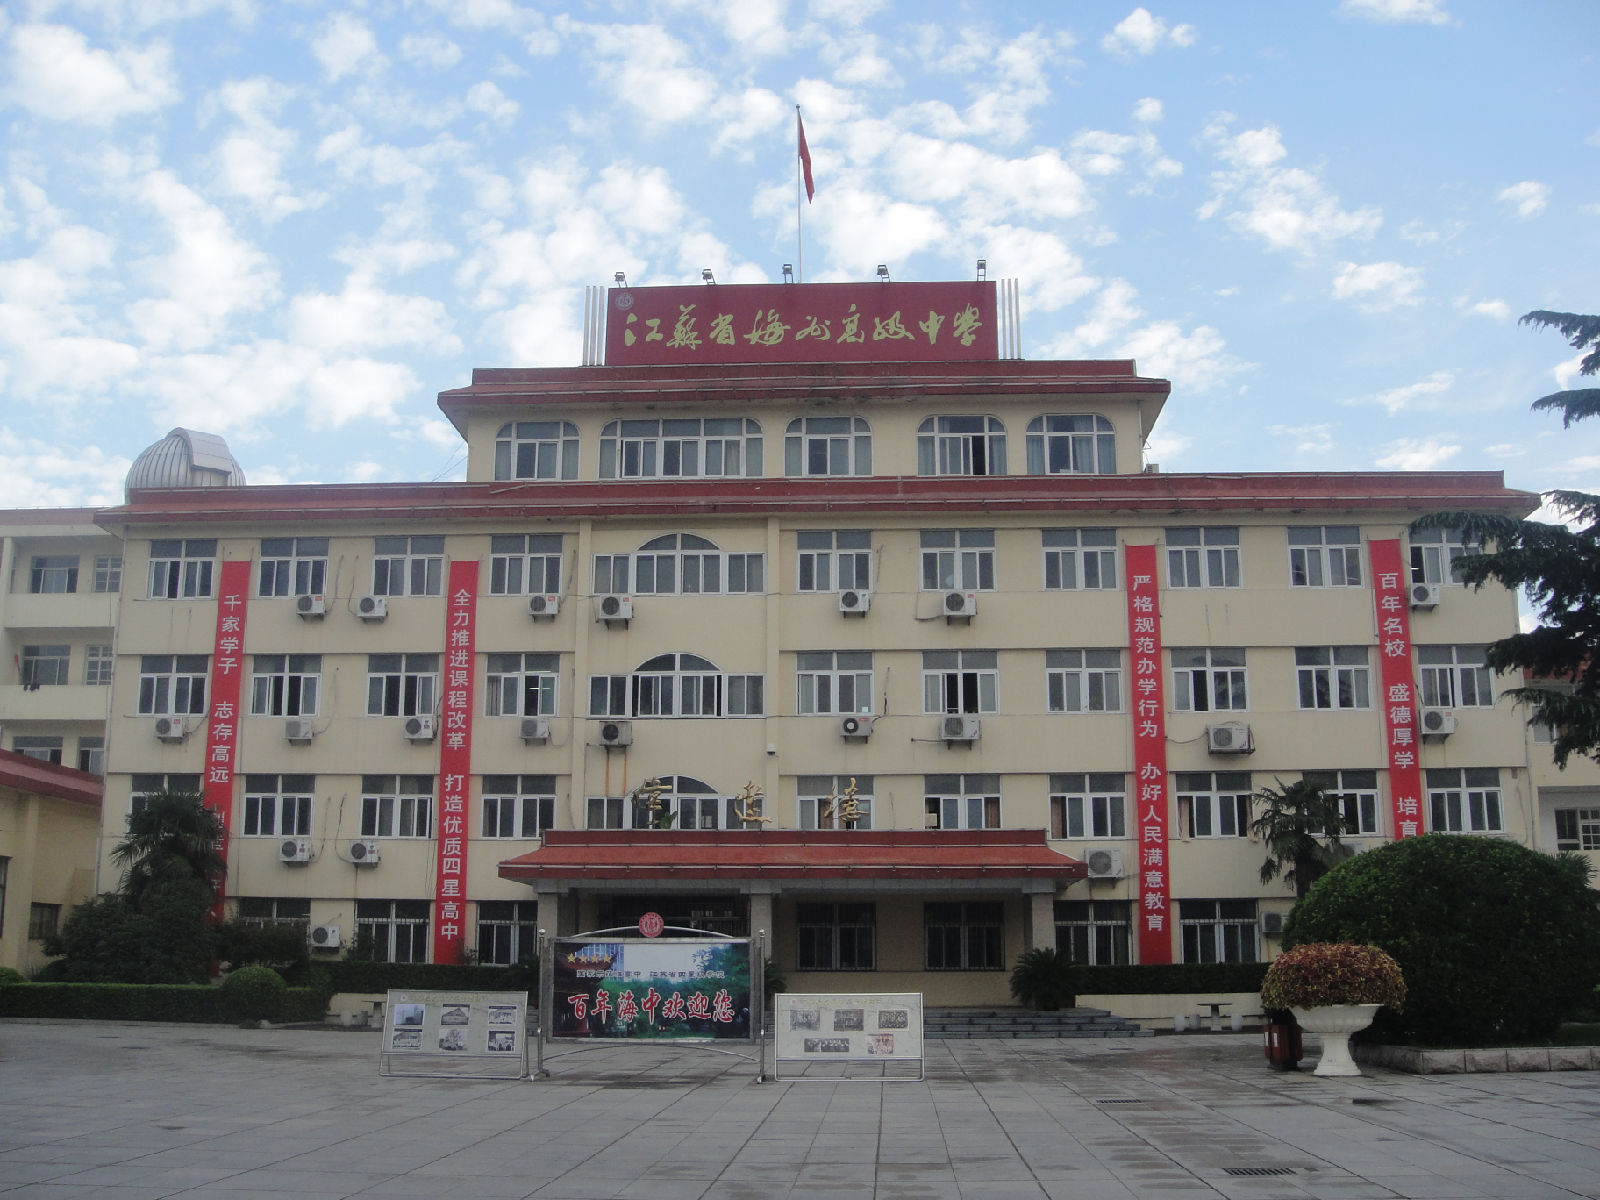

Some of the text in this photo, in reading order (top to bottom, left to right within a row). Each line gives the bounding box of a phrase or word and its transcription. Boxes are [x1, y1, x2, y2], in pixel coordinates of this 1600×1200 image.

[217, 594, 242, 675] 千家学子
[1378, 572, 1419, 838] 百年名校 盛德厚学 培育
[209, 700, 234, 783] 志存高远
[441, 588, 472, 940] 全力推进课程改革 打造优质四星高中
[1132, 575, 1165, 932] 严格规范办学行为 办好人民满意教育
[567, 987, 736, 1025] 百年海中欢迎您
